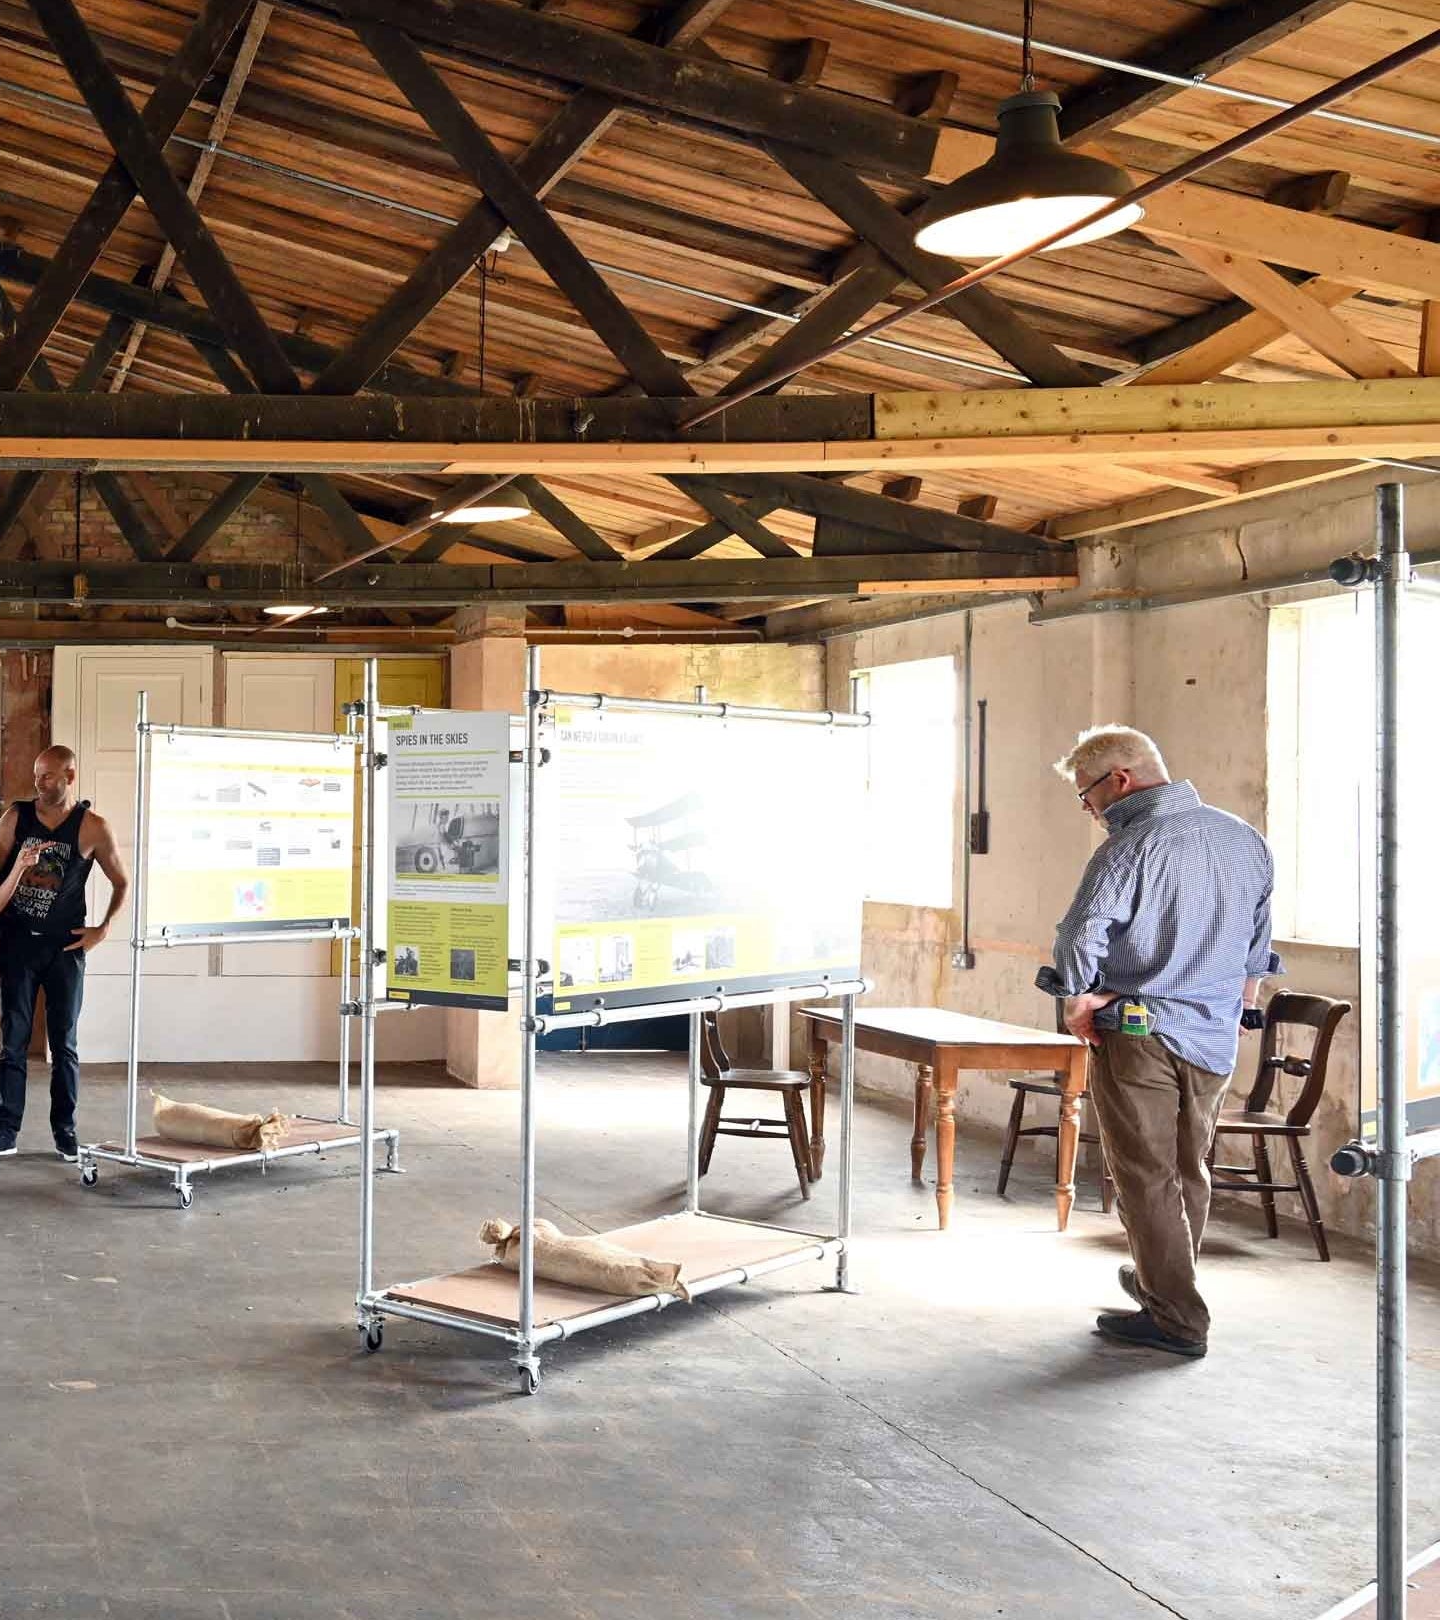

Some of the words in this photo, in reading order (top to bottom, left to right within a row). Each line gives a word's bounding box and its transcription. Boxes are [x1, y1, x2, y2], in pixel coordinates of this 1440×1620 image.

[396, 735, 417, 746] SPIES
[419, 734, 428, 745] IN
[430, 733, 443, 745] THE
[445, 732, 469, 745] SKIES
